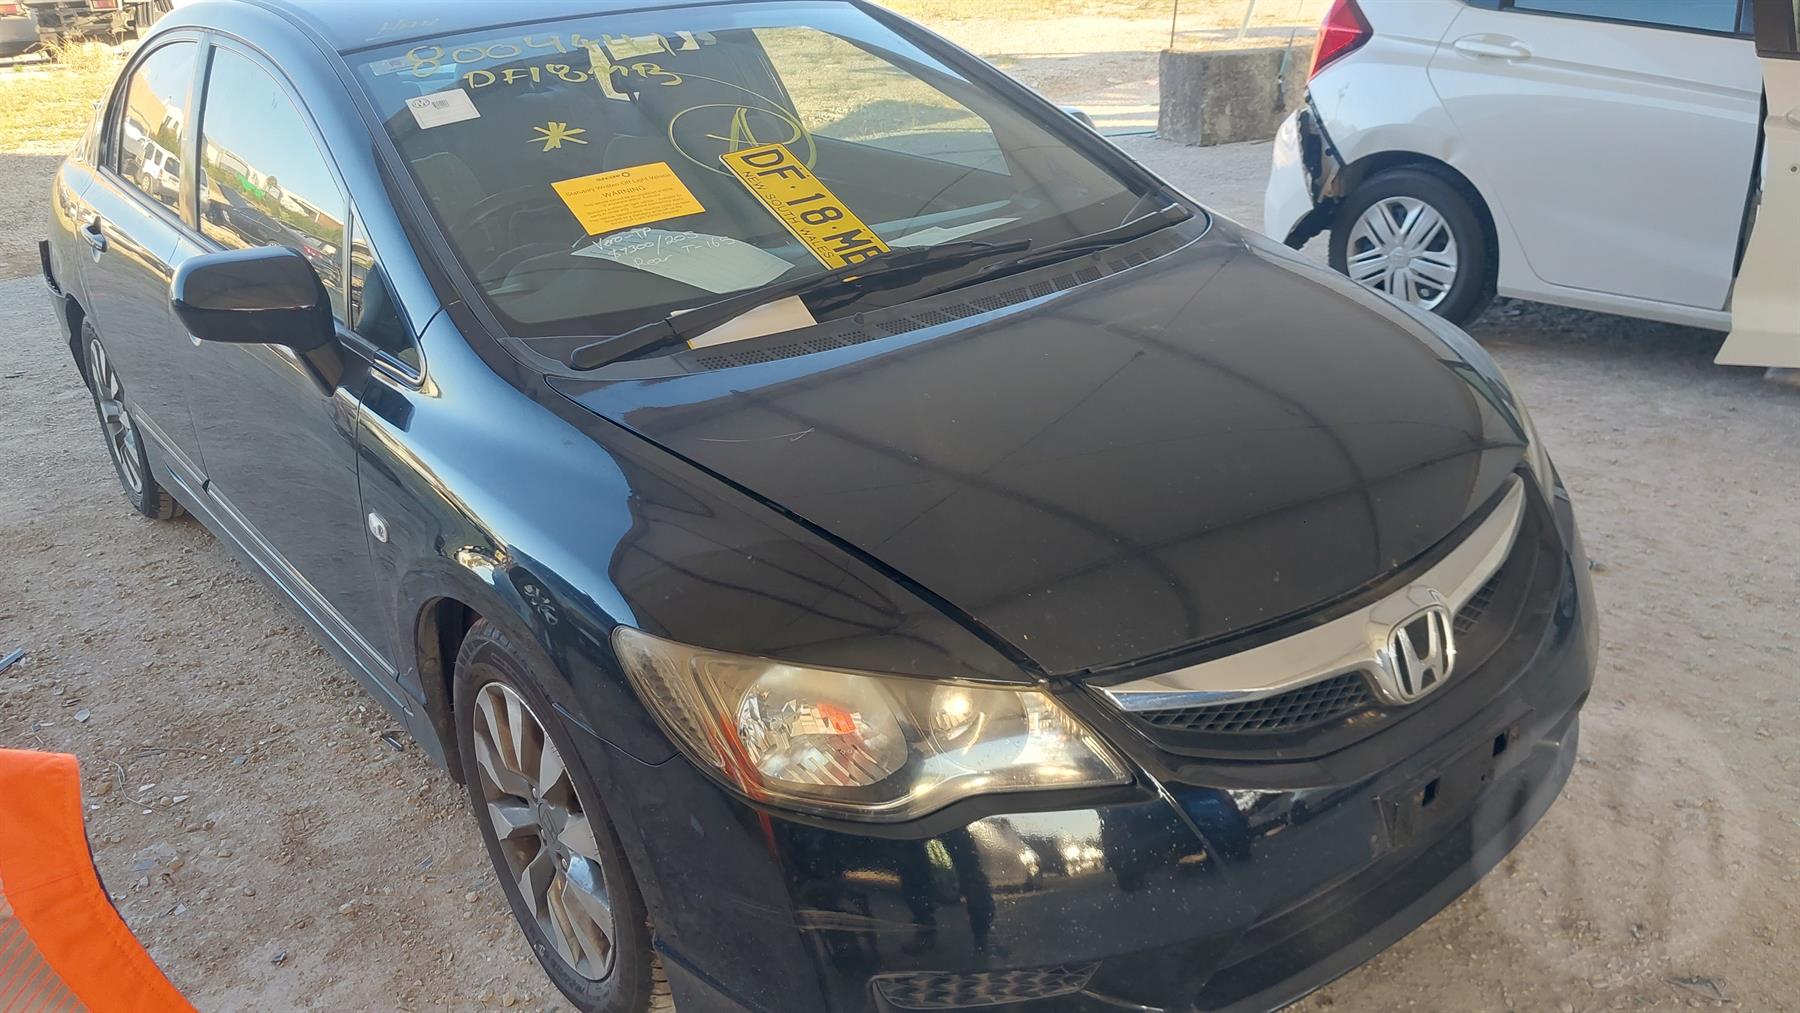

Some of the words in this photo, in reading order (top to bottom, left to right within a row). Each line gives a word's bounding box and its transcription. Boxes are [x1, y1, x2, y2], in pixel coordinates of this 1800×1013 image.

[602, 186, 646, 199] WARNING
[743, 171, 768, 191] NEW
[765, 193, 801, 224] SOUTH
[800, 227, 836, 259] WALES
